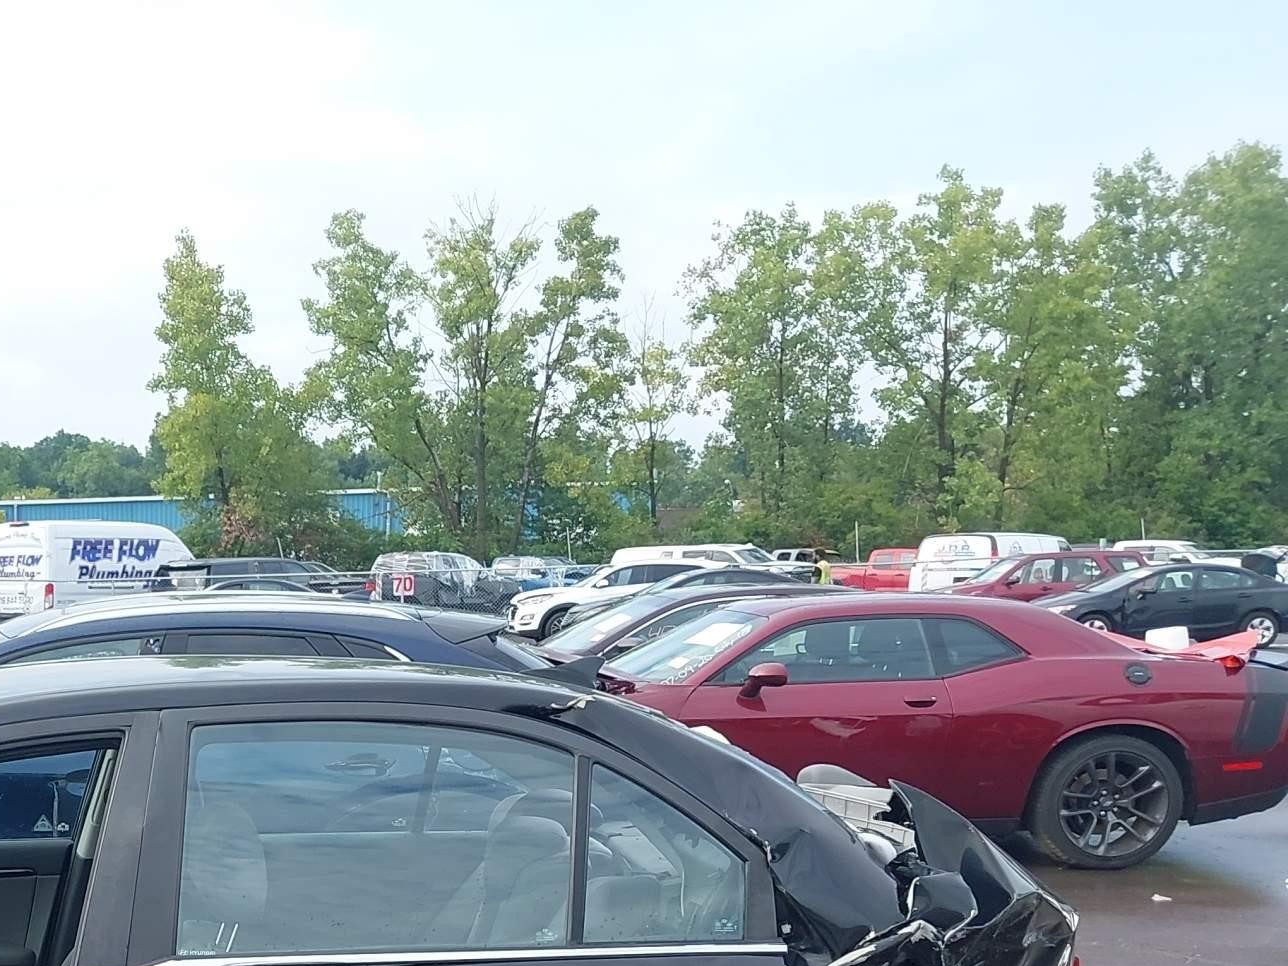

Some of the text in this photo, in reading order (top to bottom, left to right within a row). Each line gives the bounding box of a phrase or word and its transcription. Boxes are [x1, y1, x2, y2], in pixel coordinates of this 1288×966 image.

[69, 538, 160, 562] FREE FLOW
[16, 555, 42, 568] FLOW
[392, 577, 413, 592] 70
